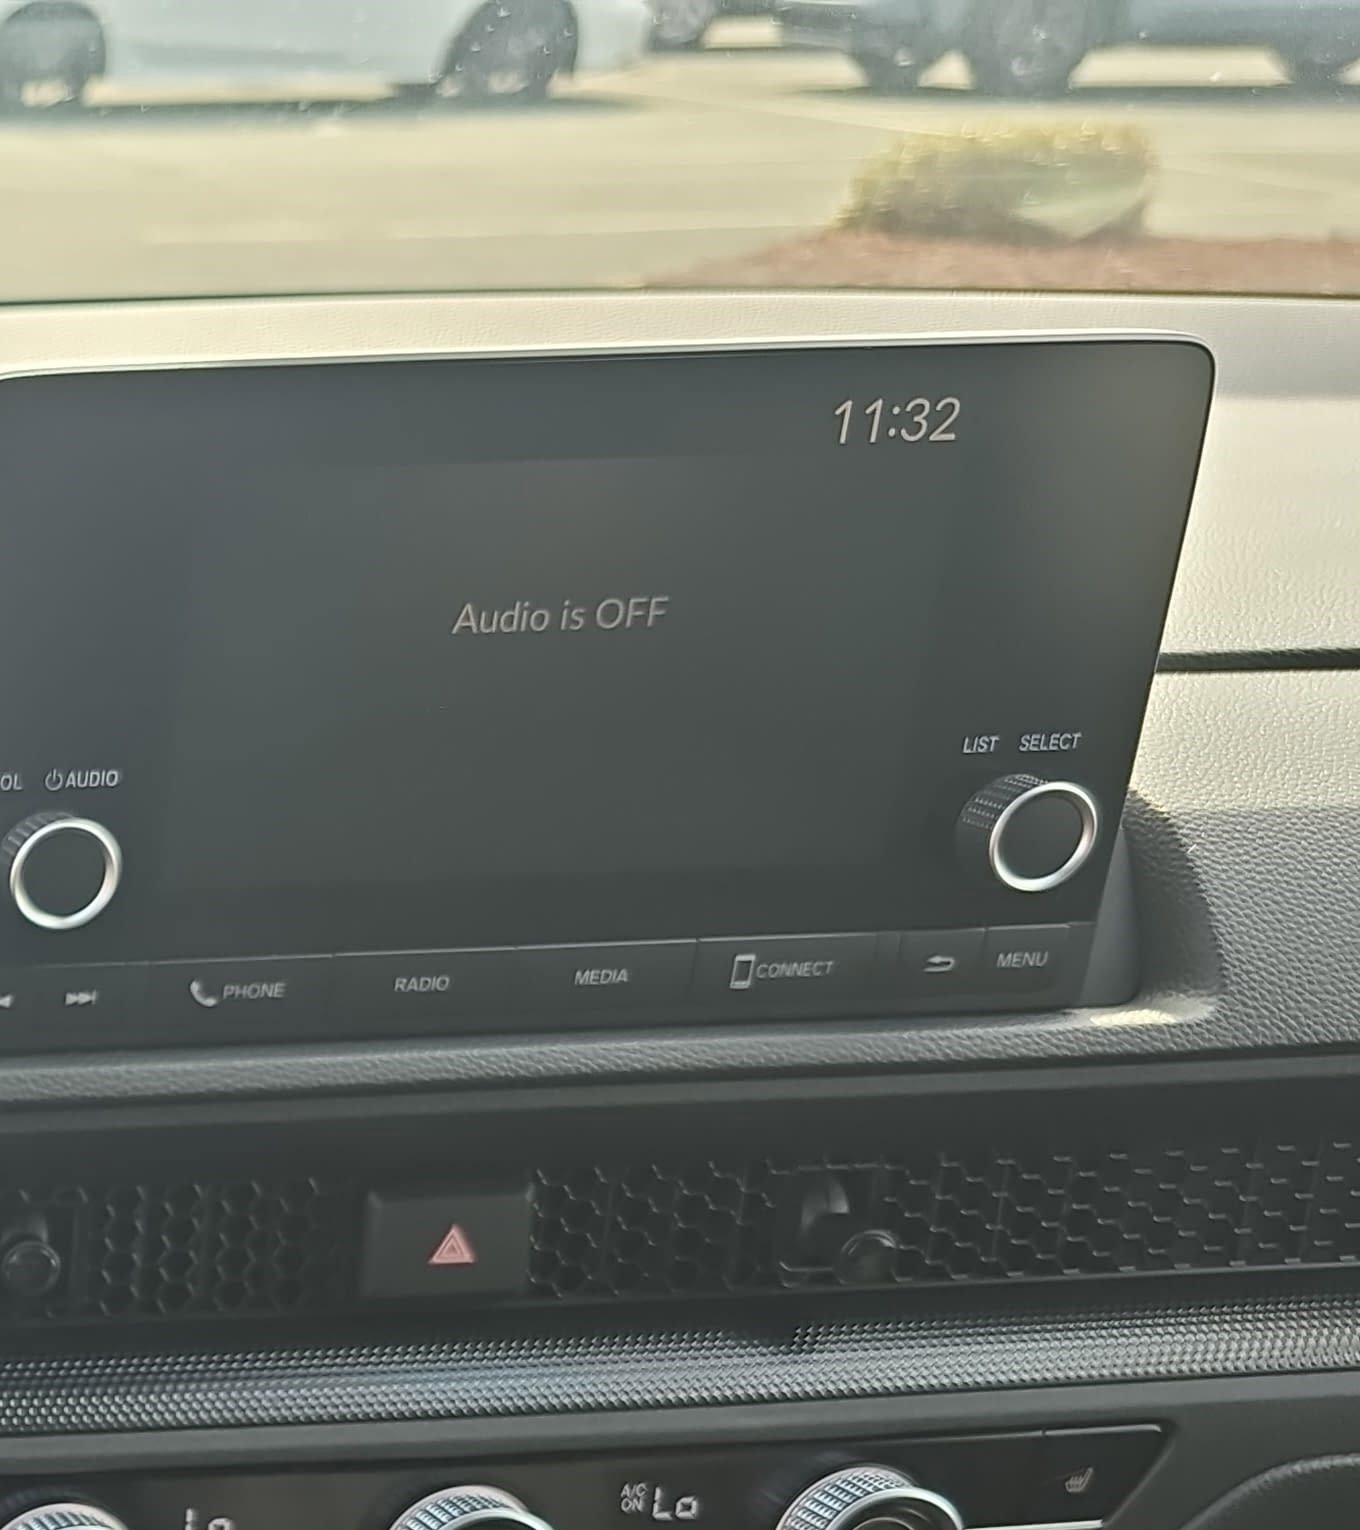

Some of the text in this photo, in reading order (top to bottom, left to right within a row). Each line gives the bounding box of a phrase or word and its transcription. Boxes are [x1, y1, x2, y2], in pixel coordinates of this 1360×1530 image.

[832, 396, 963, 445] 11:32
[451, 595, 670, 635] Audio is OFF
[962, 732, 1083, 755] LIST SELECT
[64, 769, 121, 790] AUDIO
[996, 950, 1050, 969] MENU
[574, 967, 630, 987] MEDIA
[755, 959, 835, 981] CONNECT
[222, 983, 286, 1001] PHONE
[394, 974, 451, 993] RADIO
[620, 1481, 649, 1498] A/C
[620, 1497, 645, 1513] ON
